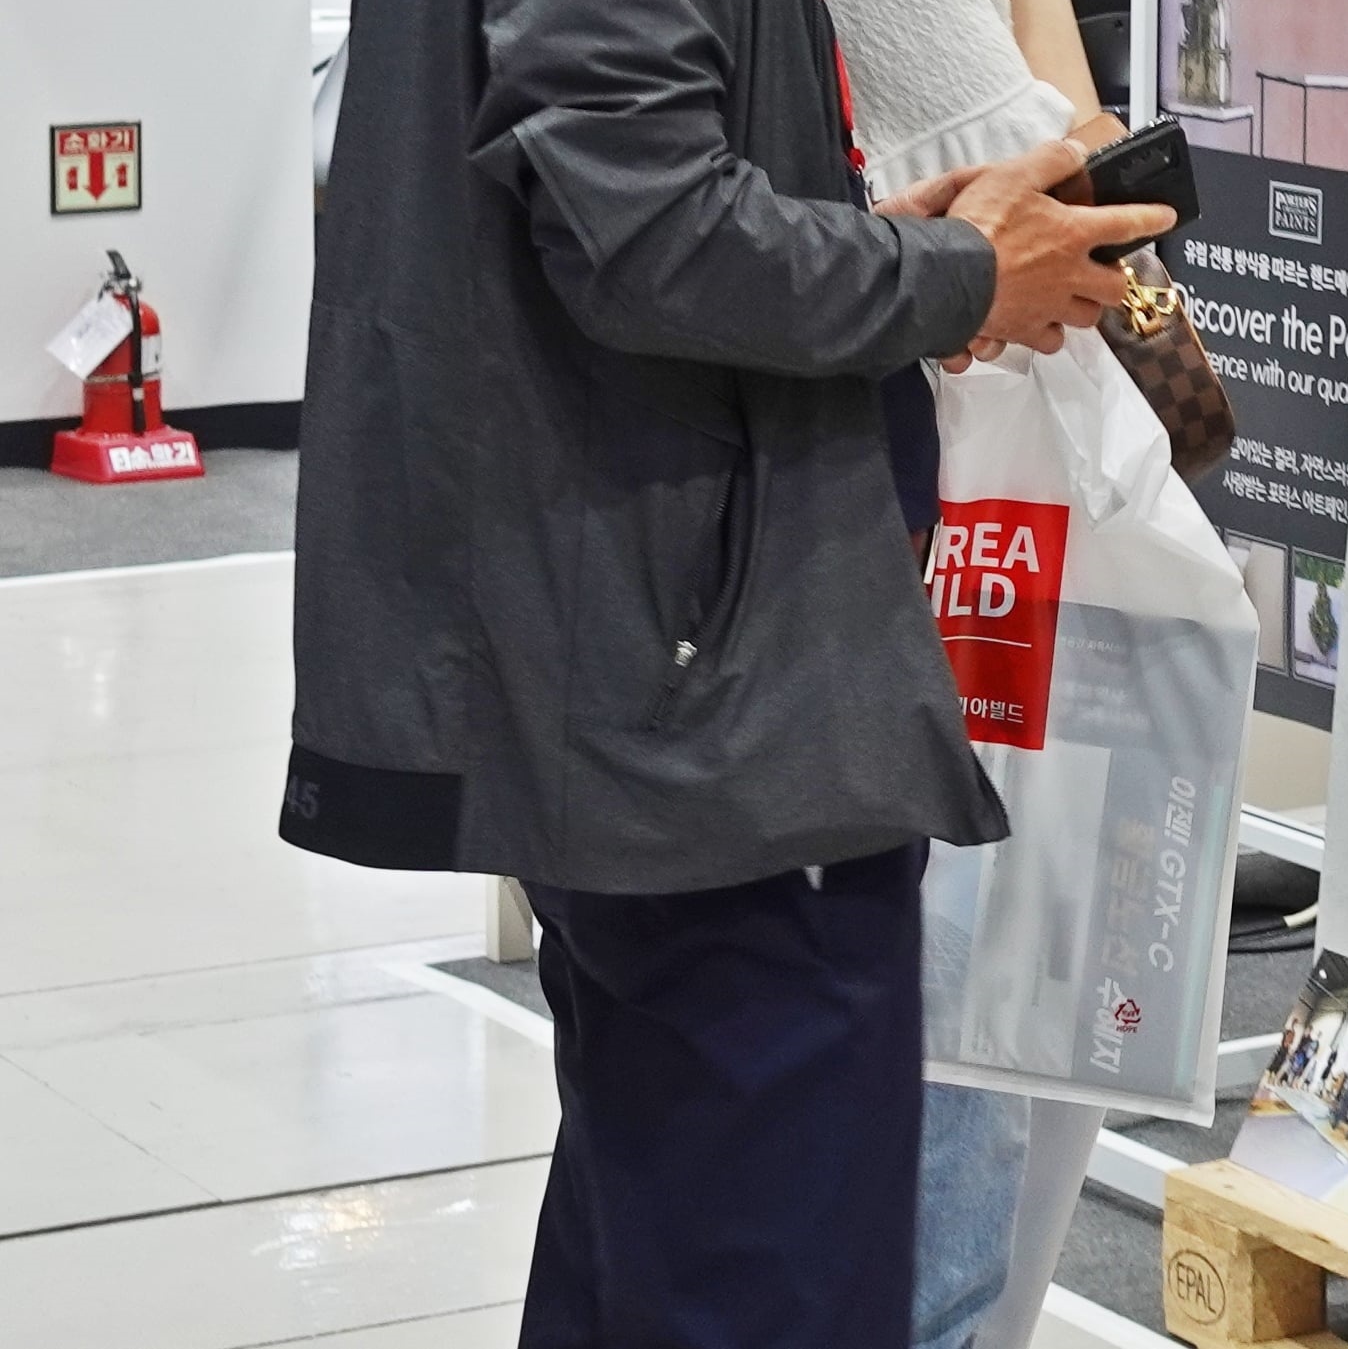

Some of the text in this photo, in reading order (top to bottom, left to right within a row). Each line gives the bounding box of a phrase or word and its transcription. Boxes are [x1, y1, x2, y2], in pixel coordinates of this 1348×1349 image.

[1274, 210, 1317, 233] PAINTS
[1184, 239, 1208, 268] 유럽
[1209, 243, 1234, 273] 전통
[1234, 249, 1270, 281] 방식을
[1271, 257, 1309, 288] 따르는
[1281, 304, 1323, 355] the
[1250, 357, 1285, 389] with
[1287, 369, 1316, 396] our
[1222, 469, 1267, 503] 사랑받는
[1268, 480, 1302, 510] 포터스
[1149, 849, 1187, 973] GTX-C
[1175, 1260, 1217, 1315] EPAL
